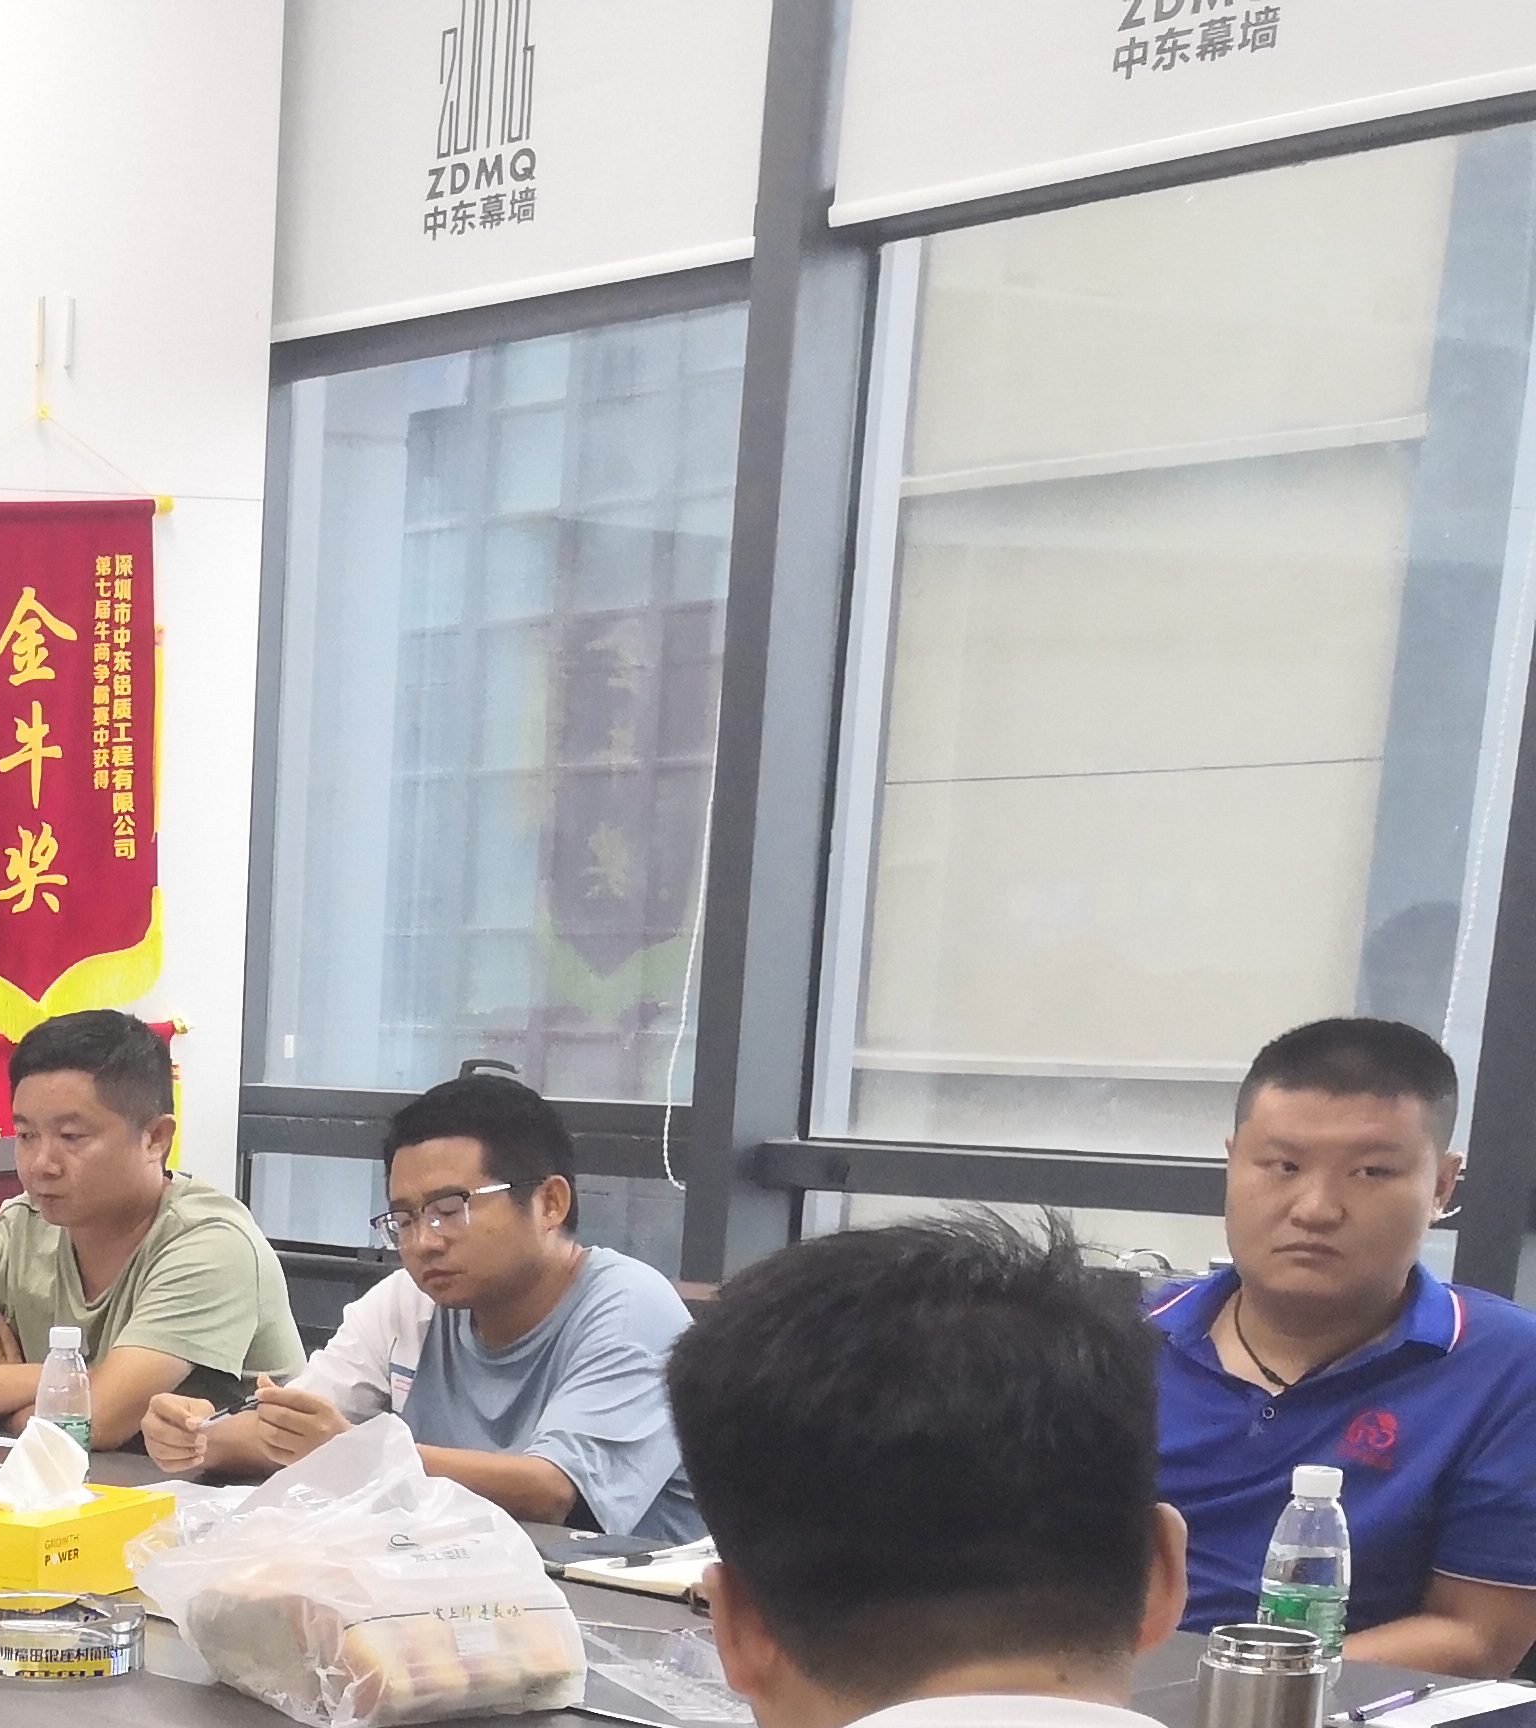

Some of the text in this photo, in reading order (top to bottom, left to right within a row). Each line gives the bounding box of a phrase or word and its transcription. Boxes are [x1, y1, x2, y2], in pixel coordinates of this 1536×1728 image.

[1112, 4, 1282, 80] 中东幕墙
[425, 147, 536, 201] ZDMQ
[423, 186, 537, 241] 中东幕墙
[93, 555, 112, 790] 第七届牛商争霸赛中获得
[112, 554, 136, 860] 深圳市中东铝质工程有限公司
